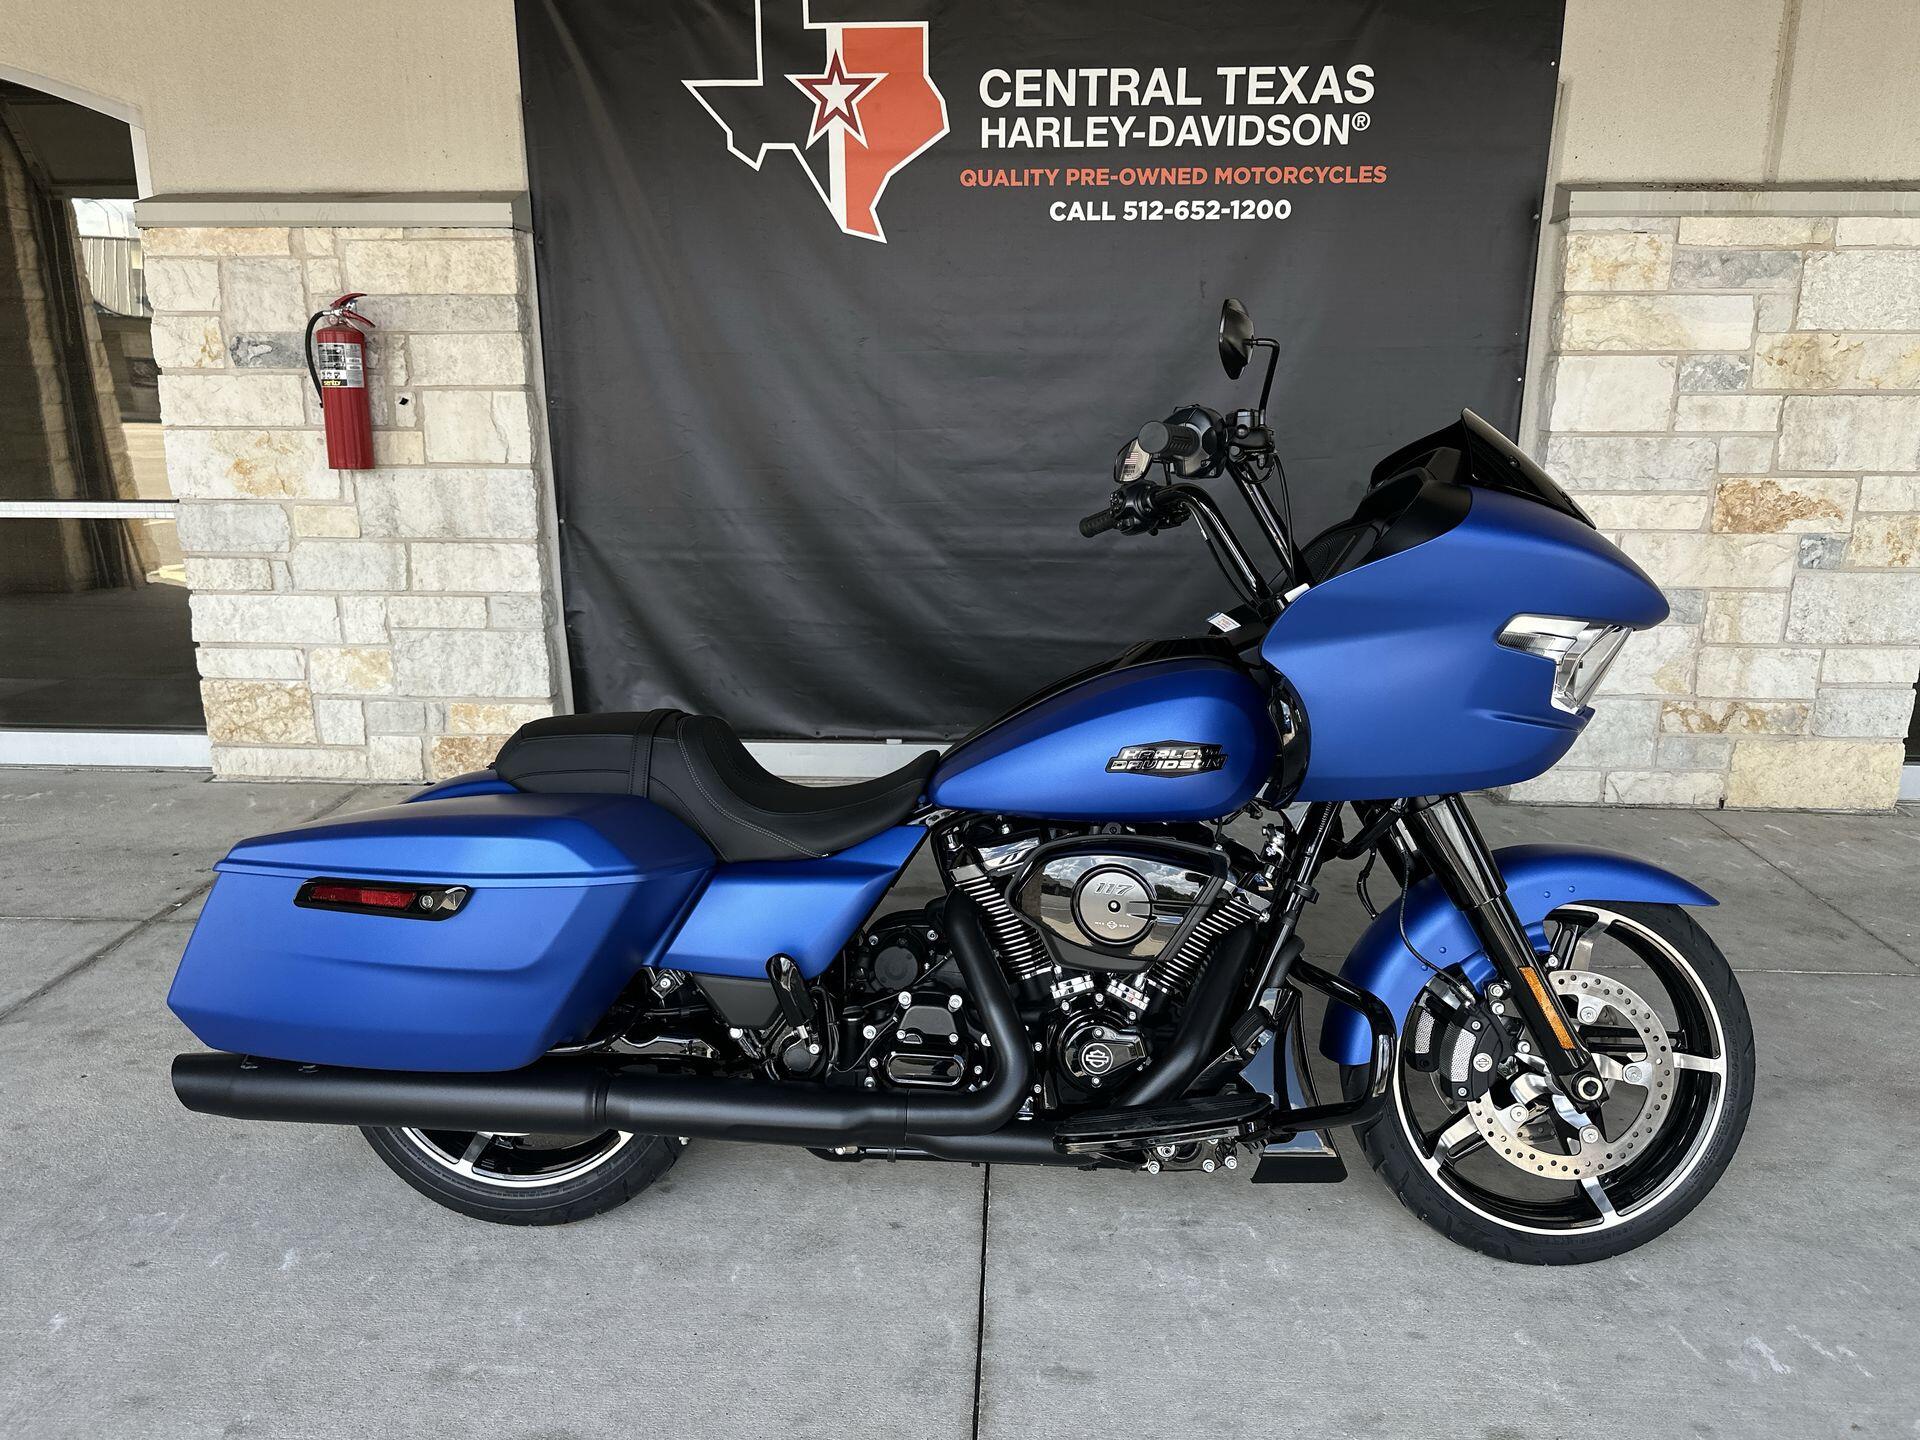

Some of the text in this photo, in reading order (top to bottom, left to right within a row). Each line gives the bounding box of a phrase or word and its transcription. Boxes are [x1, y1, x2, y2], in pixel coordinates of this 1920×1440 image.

[979, 64, 1376, 108] CENTRAL TEXAS
[981, 111, 1371, 149] HARLEY-DAVIDSON®
[959, 165, 1388, 188] QUALITY PRE-OWNED MOTORCYCLES
[1049, 199, 1292, 222] CALL 512-652-1200
[1095, 881, 1135, 896] 117
